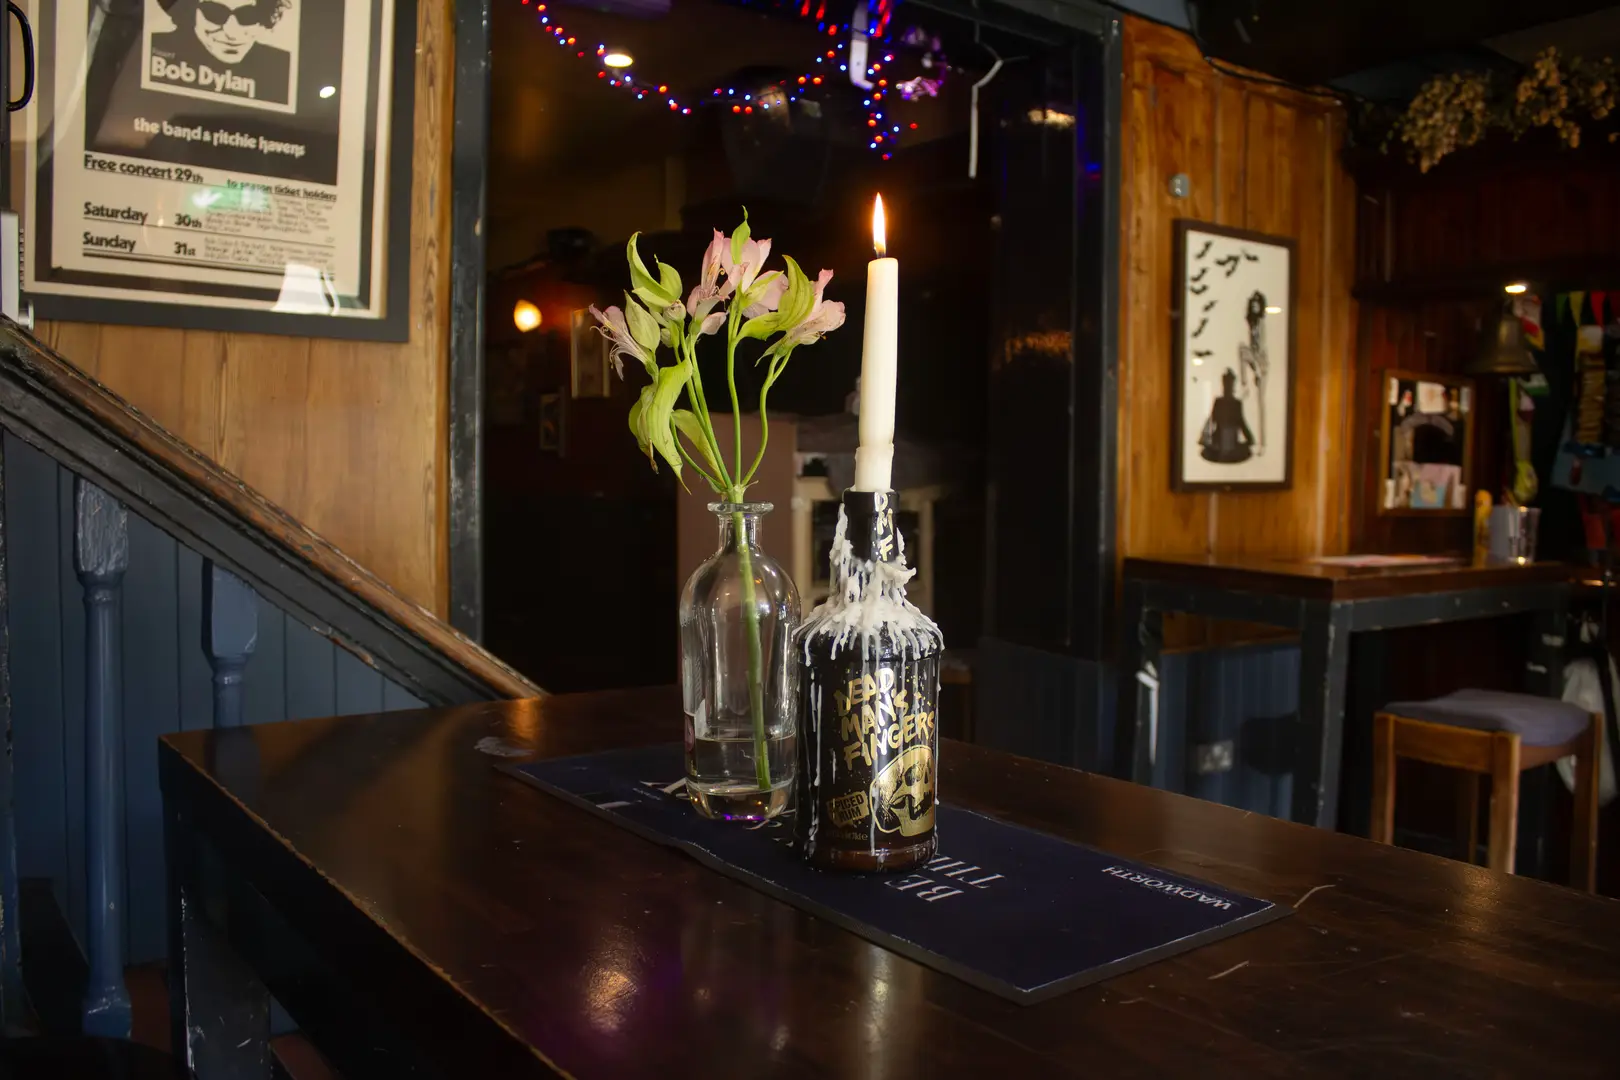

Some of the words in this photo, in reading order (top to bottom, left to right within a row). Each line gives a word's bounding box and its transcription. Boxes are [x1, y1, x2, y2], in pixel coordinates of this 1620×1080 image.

[151, 56, 197, 82] Bob
[198, 65, 256, 98] Dylan
[133, 117, 160, 134] the
[162, 121, 203, 142] band
[212, 129, 258, 150] ritchie
[258, 136, 306, 159] havens
[84, 154, 117, 171] Free
[119, 162, 172, 179] concert
[174, 168, 204, 183] 29th
[83, 201, 149, 226] Saturday
[174, 213, 203, 229] 30th
[82, 231, 136, 253] Sunday
[173, 241, 197, 256] 31st
[832, 667, 895, 717] DEAD
[841, 688, 909, 743] MAN'S
[843, 710, 935, 771] FINGERS
[839, 806, 862, 822] RUM
[884, 873, 964, 903] BE
[1101, 866, 1233, 910] WADWORTH
